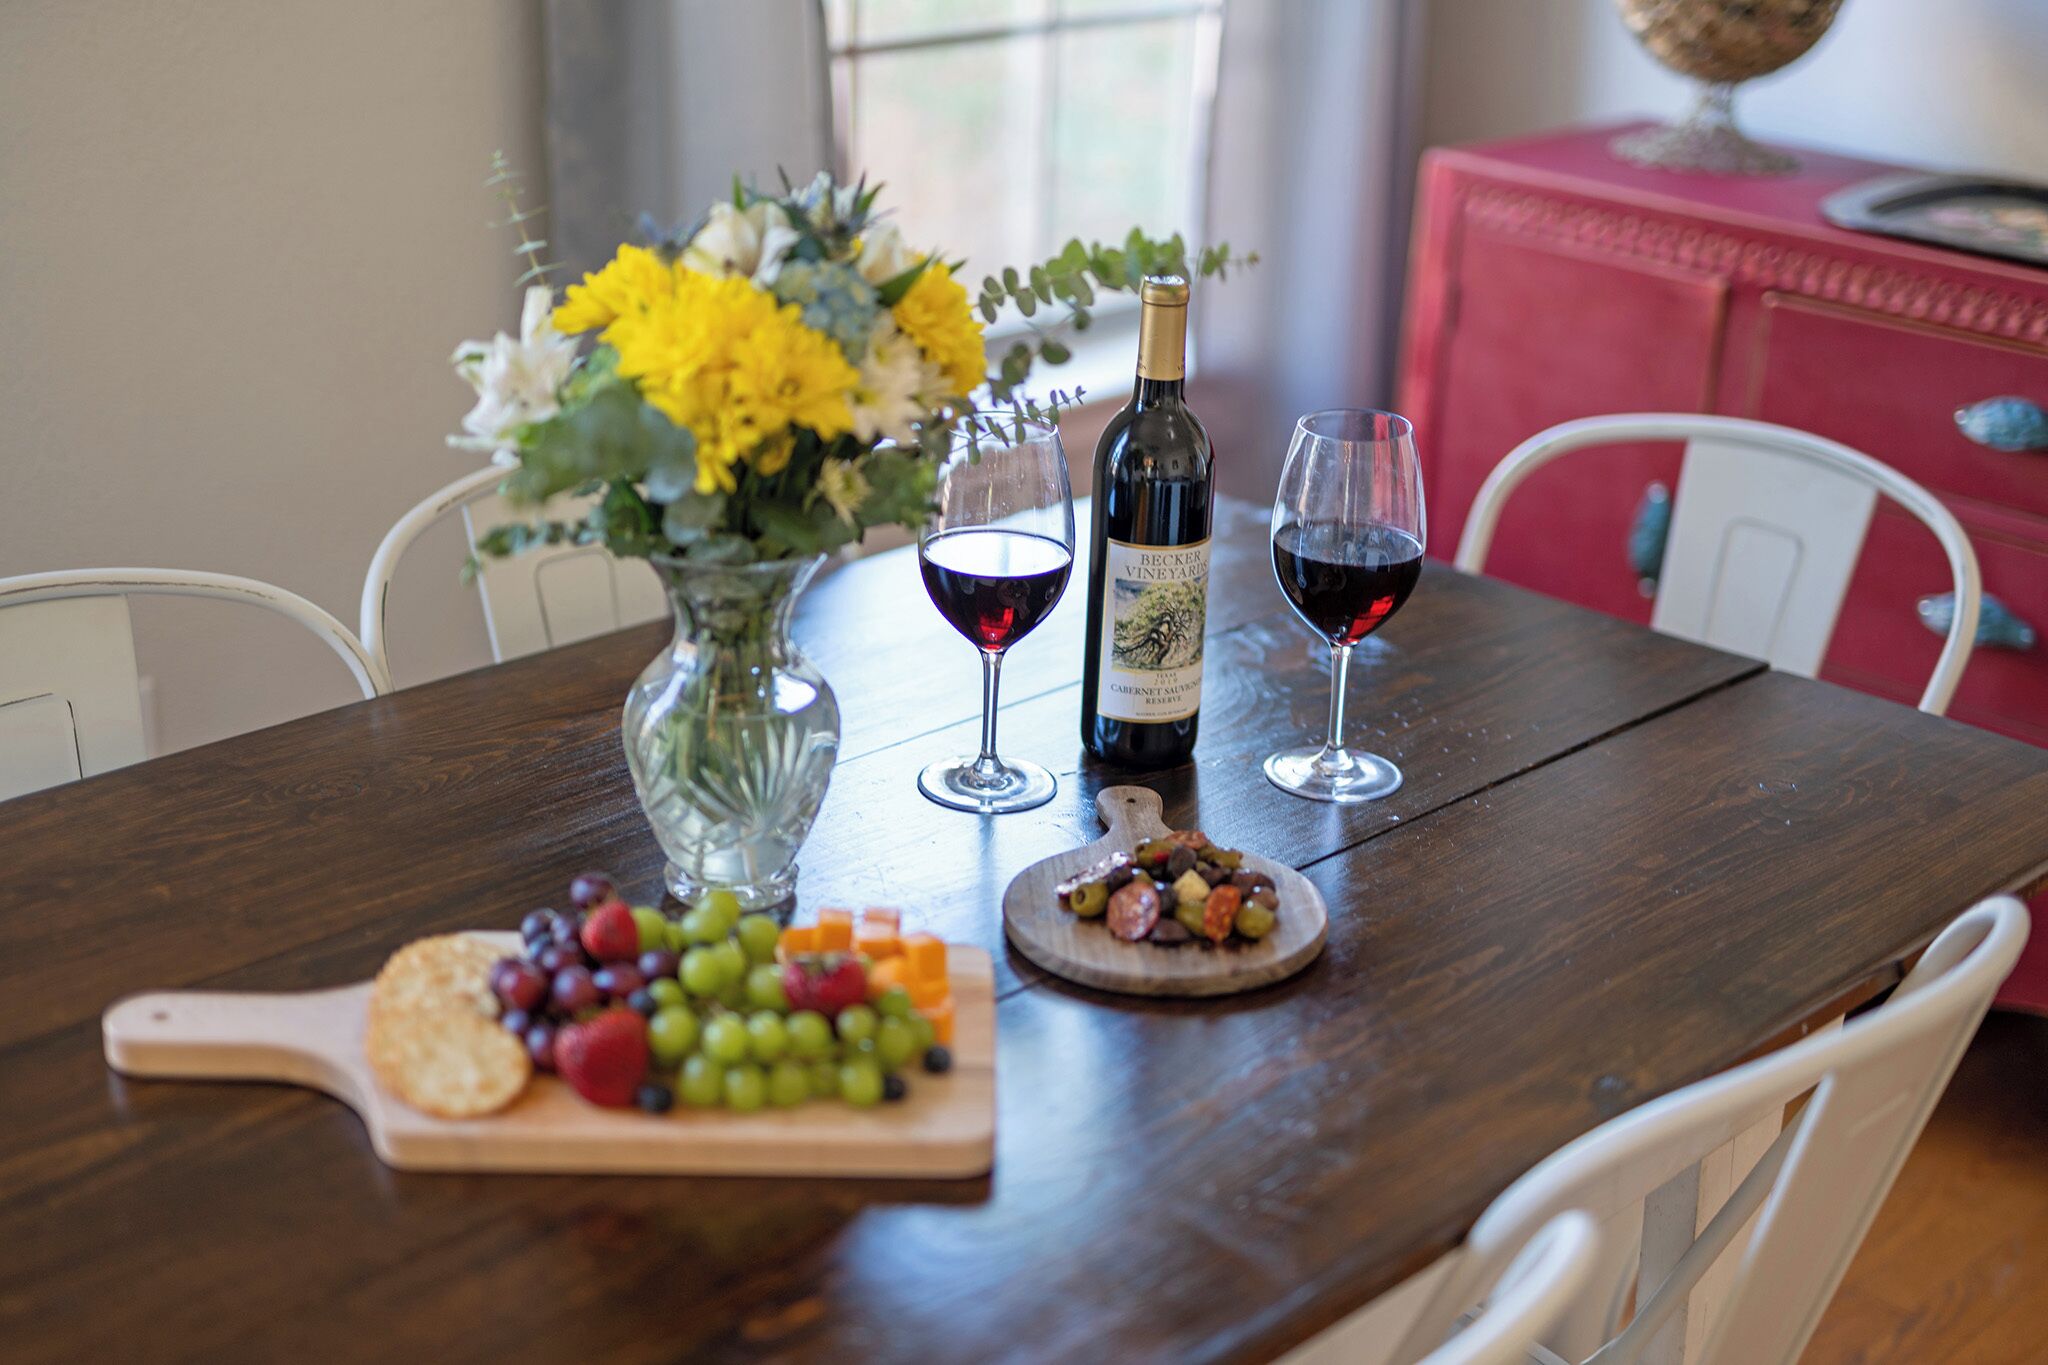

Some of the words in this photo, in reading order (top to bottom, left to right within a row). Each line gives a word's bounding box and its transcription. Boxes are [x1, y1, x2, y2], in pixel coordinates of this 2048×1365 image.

[1140, 551, 1201, 566] BECKER
[1125, 560, 1208, 579] VINEYARDS
[1110, 683, 1161, 695] CABERNET
[1145, 695, 1182, 705] RESERVE
